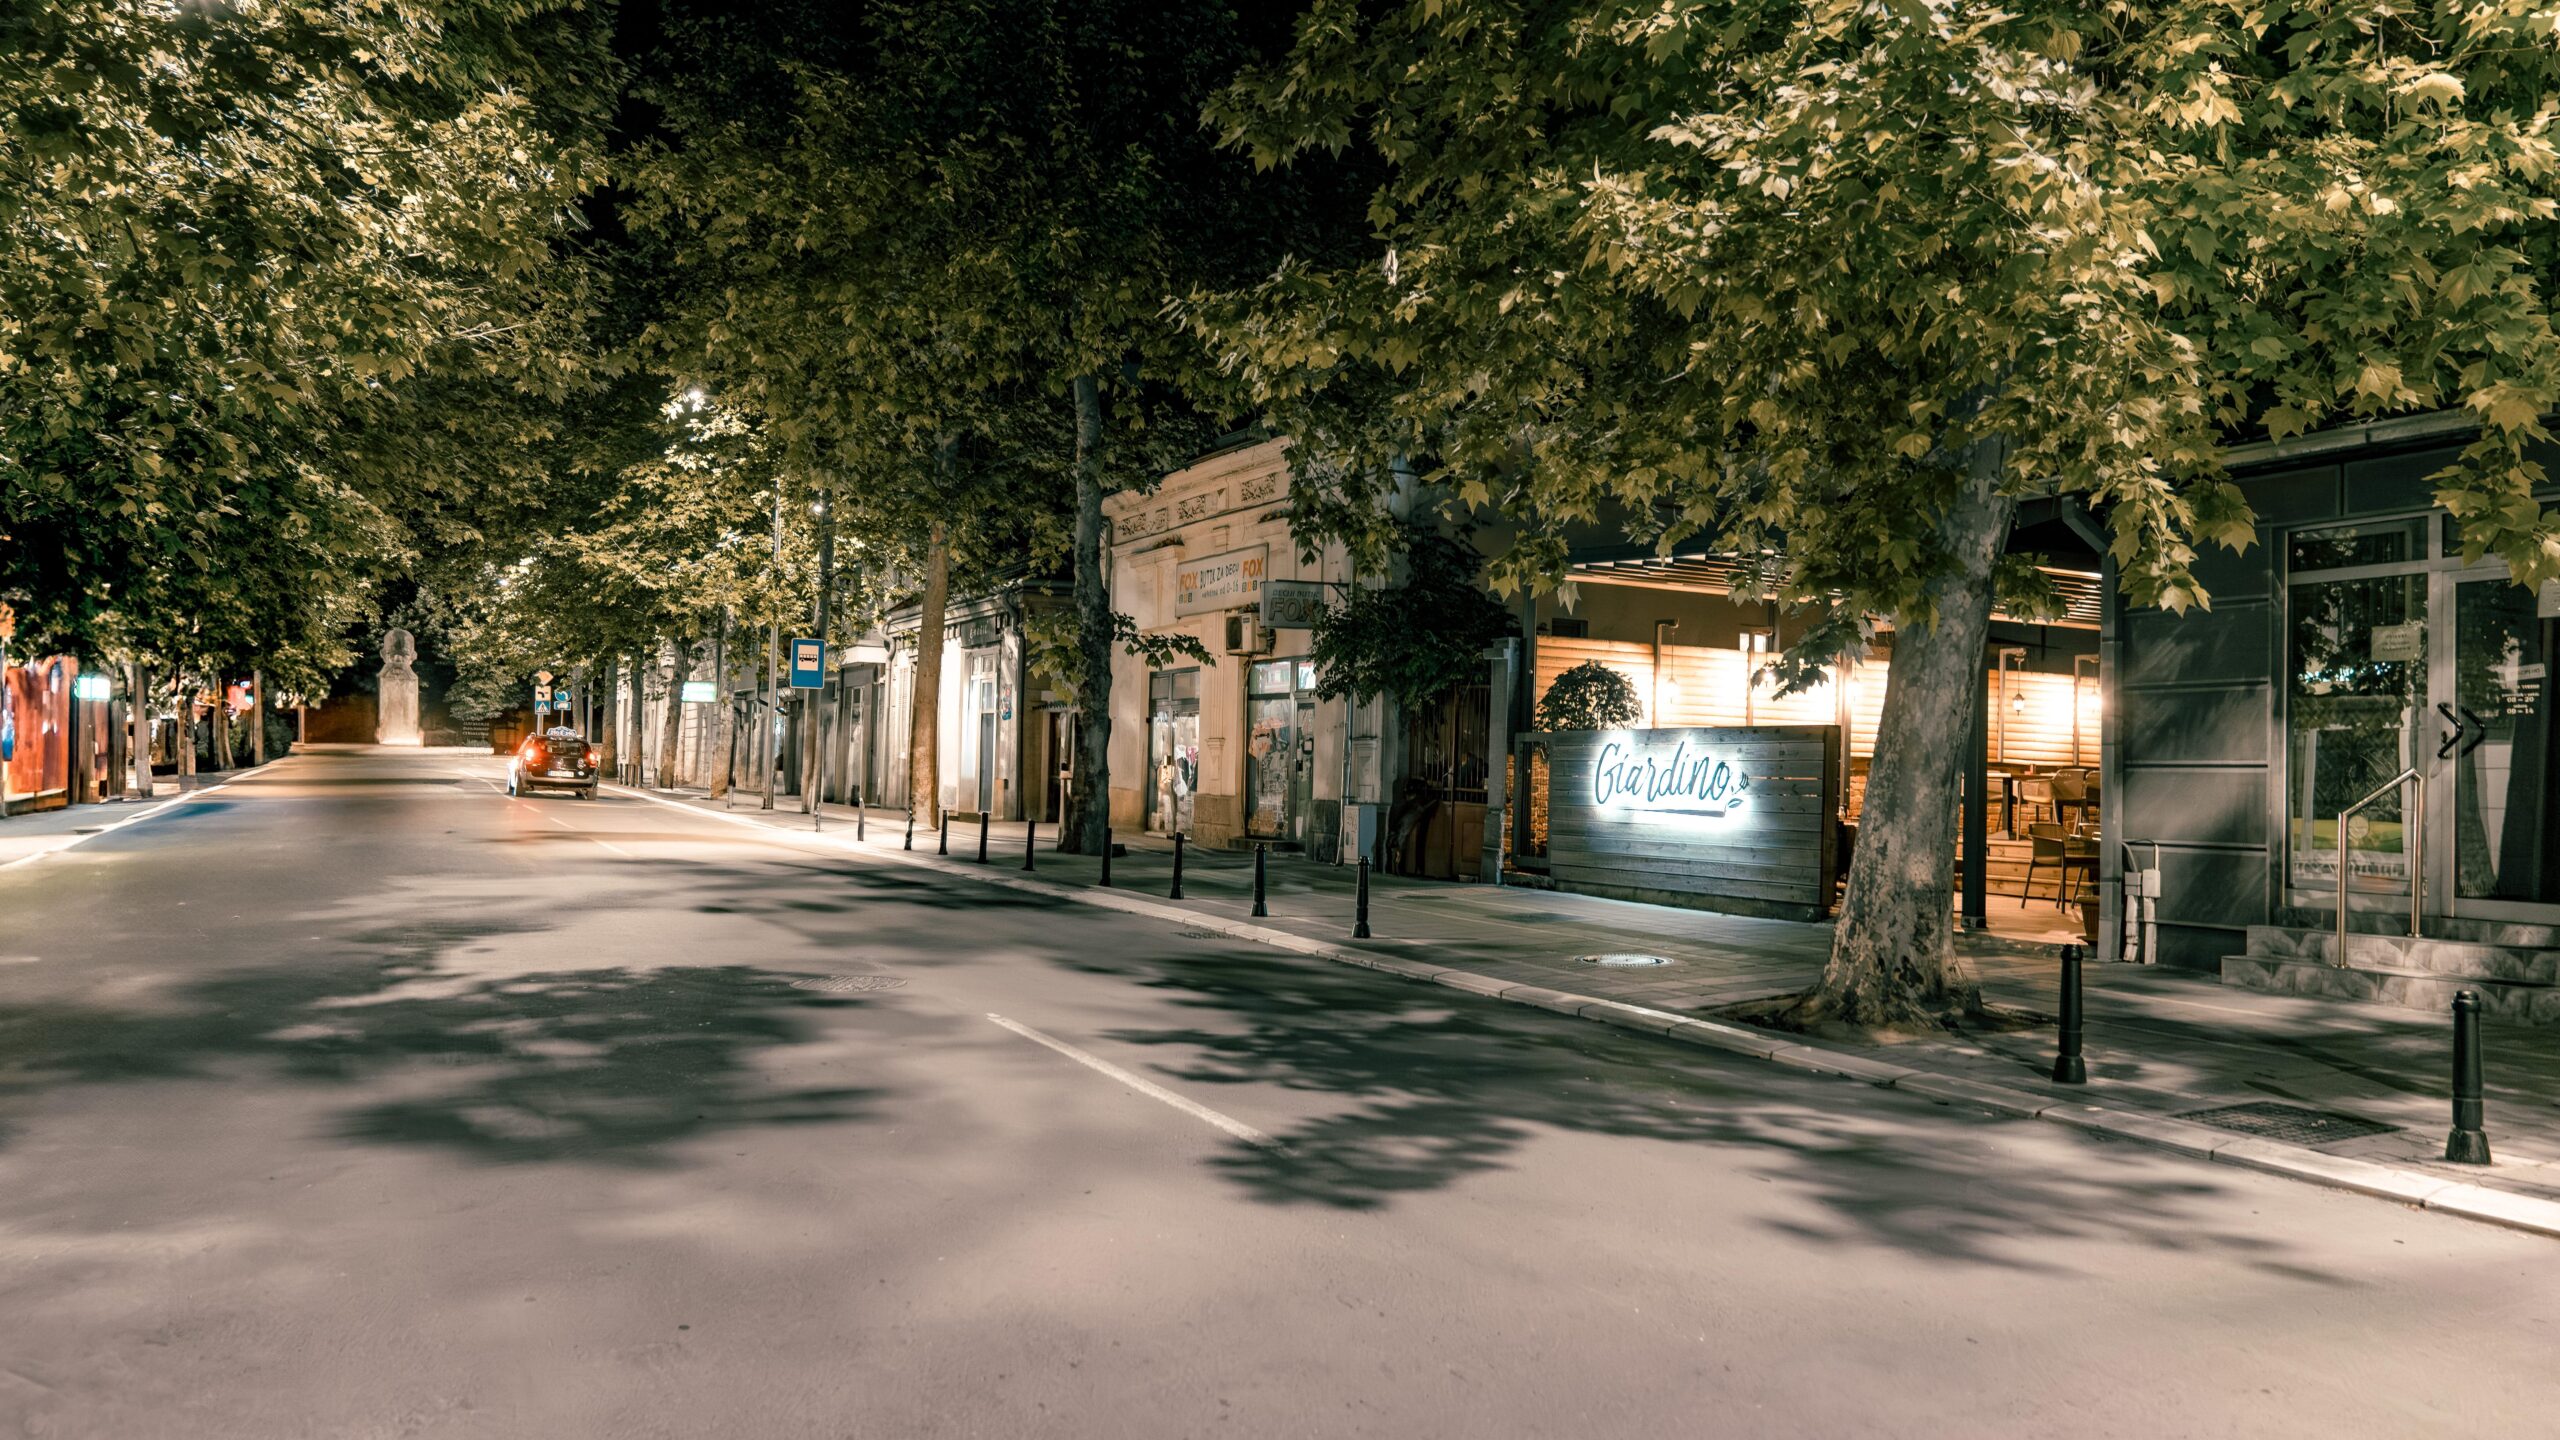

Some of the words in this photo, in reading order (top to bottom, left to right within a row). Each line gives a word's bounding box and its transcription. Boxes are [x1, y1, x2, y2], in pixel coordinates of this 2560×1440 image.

[1242, 557, 1264, 578] FOX
[1180, 571, 1198, 591] FOX
[1268, 597, 1319, 622] FOX
[1595, 741, 1730, 804] Giardino
